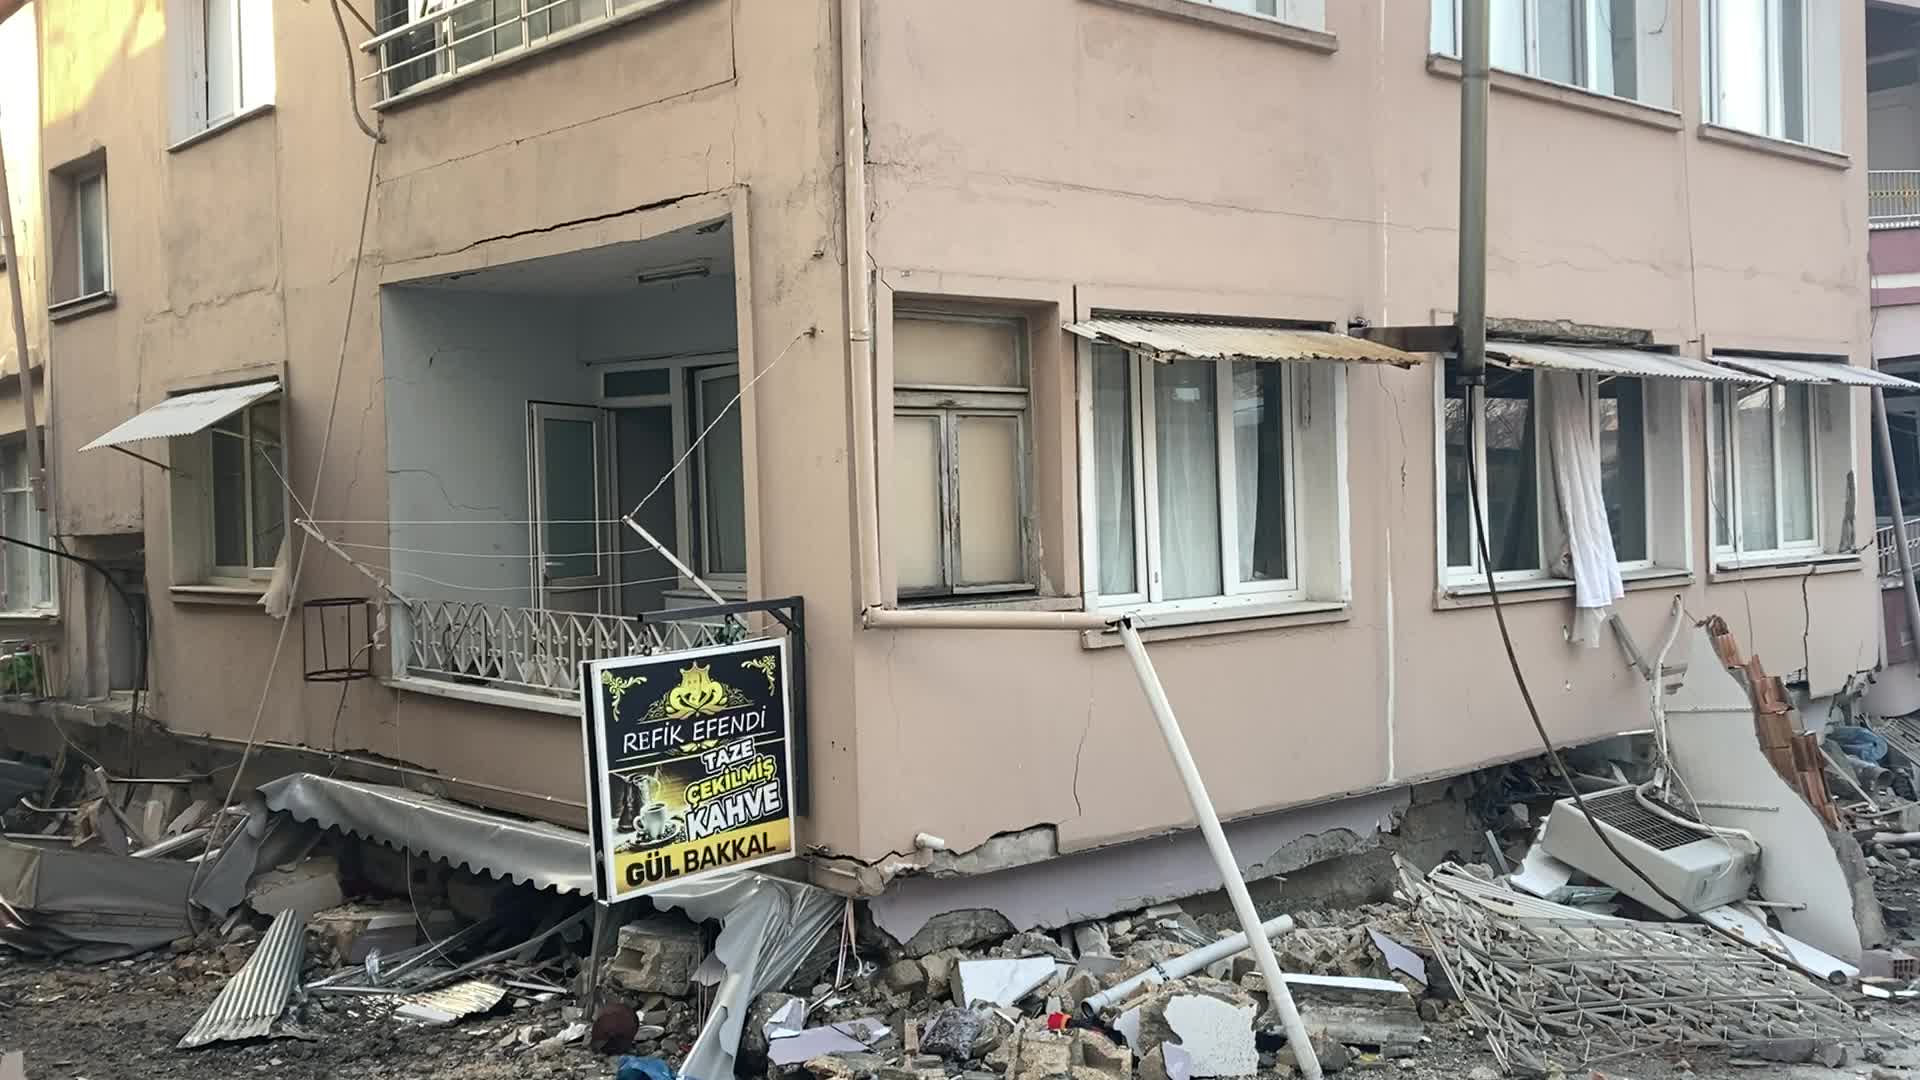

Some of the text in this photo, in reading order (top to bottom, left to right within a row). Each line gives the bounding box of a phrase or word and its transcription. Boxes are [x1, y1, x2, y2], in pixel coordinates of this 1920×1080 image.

[623, 705, 767, 753] REFİK EFENDİ
[703, 739, 755, 771] TAZE
[685, 756, 776, 806] ÇEKİLMİŞ
[686, 782, 782, 842] KAHVE
[626, 832, 776, 887] GÜL BAKKAL
